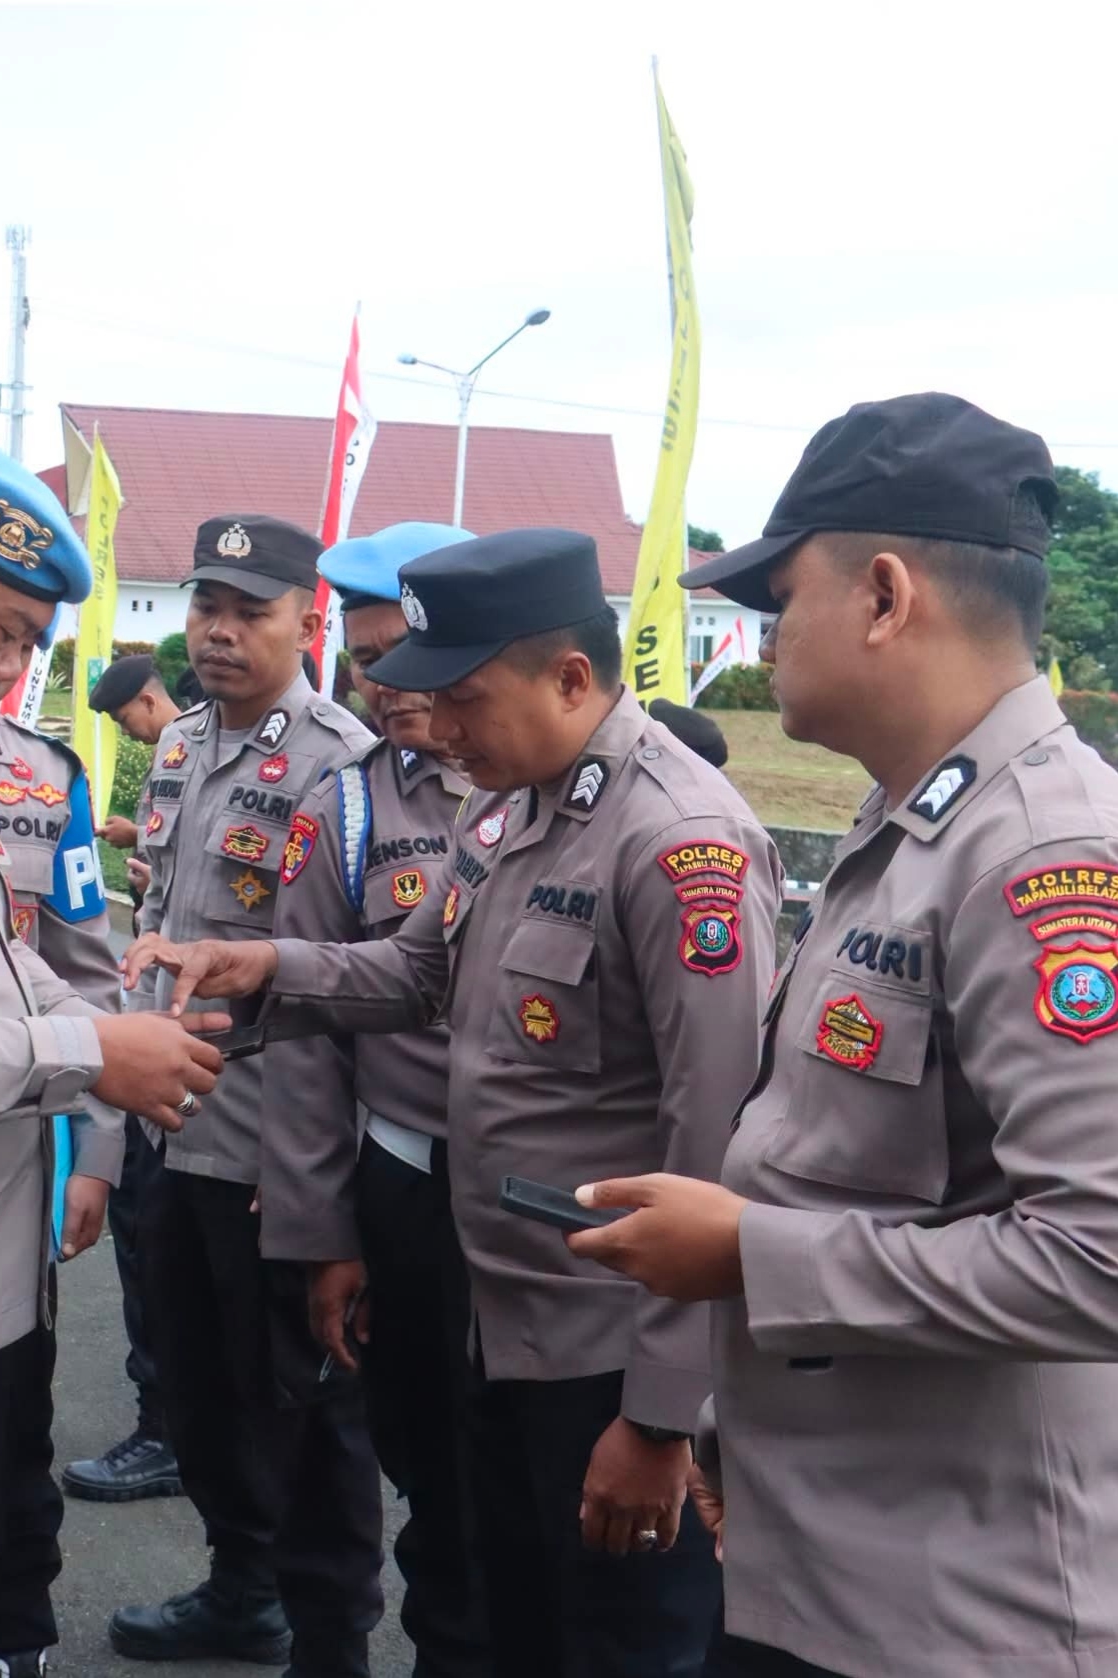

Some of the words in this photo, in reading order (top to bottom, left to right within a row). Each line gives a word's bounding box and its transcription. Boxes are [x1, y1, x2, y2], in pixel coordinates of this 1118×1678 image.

[228, 786, 292, 820] POLRI
[666, 846, 743, 868] POLRES
[527, 886, 596, 922] POLRI
[1016, 884, 1076, 907] TAPANULI
[1077, 884, 1118, 901] SELATA
[1037, 917, 1085, 935] SUMATERA
[1087, 917, 1117, 932] UTARA
